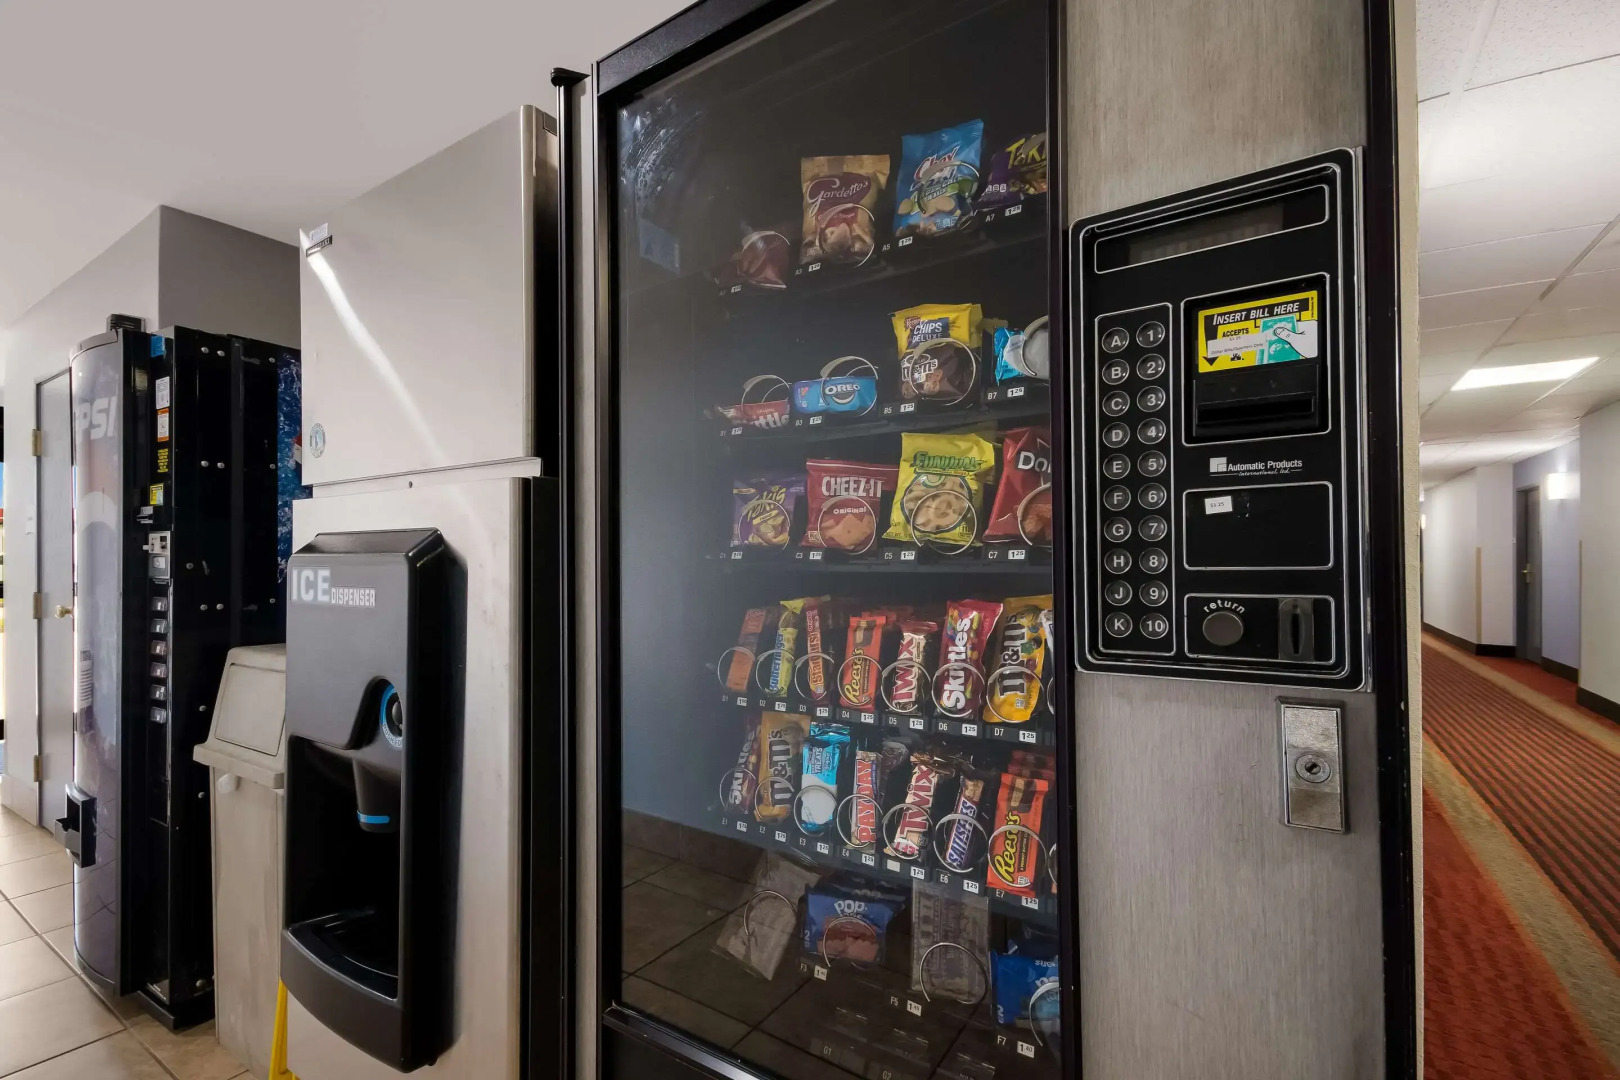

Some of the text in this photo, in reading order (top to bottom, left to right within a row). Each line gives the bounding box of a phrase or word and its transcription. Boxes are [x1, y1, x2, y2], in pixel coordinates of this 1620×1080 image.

[985, 214, 995, 223] A7
[882, 244, 891, 252] A5
[1212, 311, 1248, 326] INSERT
[1249, 307, 1270, 320] BILL
[1273, 302, 1300, 315] HERE
[913, 321, 943, 335] CHIPS
[1221, 327, 1250, 338] ACCEPTS
[1111, 335, 1121, 347] A
[1147, 329, 1154, 341] 1
[1111, 366, 1121, 378] B
[1147, 362, 1156, 374] 2
[824, 383, 861, 395] OREO
[988, 392, 997, 400] B7
[1147, 393, 1156, 406] 3
[1111, 398, 1122, 410] C
[1112, 430, 1122, 441] D
[1147, 426, 1156, 438] 4
[1113, 461, 1122, 473] E
[1148, 459, 1157, 470] 5
[1228, 459, 1303, 472] Automatic Products
[1113, 493, 1122, 505] F
[1148, 490, 1157, 502] 6
[1112, 524, 1124, 536] G
[1149, 523, 1158, 534] 7
[885, 552, 893, 560] C5
[988, 551, 998, 559] C7
[1149, 555, 1158, 567] 8
[1113, 556, 1124, 567] H
[292, 568, 376, 607] ICE DISPENSER
[1115, 587, 1123, 599] J
[1150, 588, 1159, 600] 9
[1203, 599, 1246, 615] return
[1115, 619, 1125, 631] K
[1147, 620, 1163, 632] 10
[888, 717, 897, 725] D5
[938, 722, 948, 731] D6
[994, 727, 1004, 736] D7
[855, 758, 878, 843] PAYDAY
[799, 838, 806, 846] E3
[842, 849, 850, 857] E4
[940, 874, 949, 883] E6
[800, 963, 807, 972] F3
[890, 996, 899, 1007] F5
[997, 1034, 1007, 1046] F7
[823, 1045, 832, 1055] G1
[882, 1070, 892, 1080] G2
